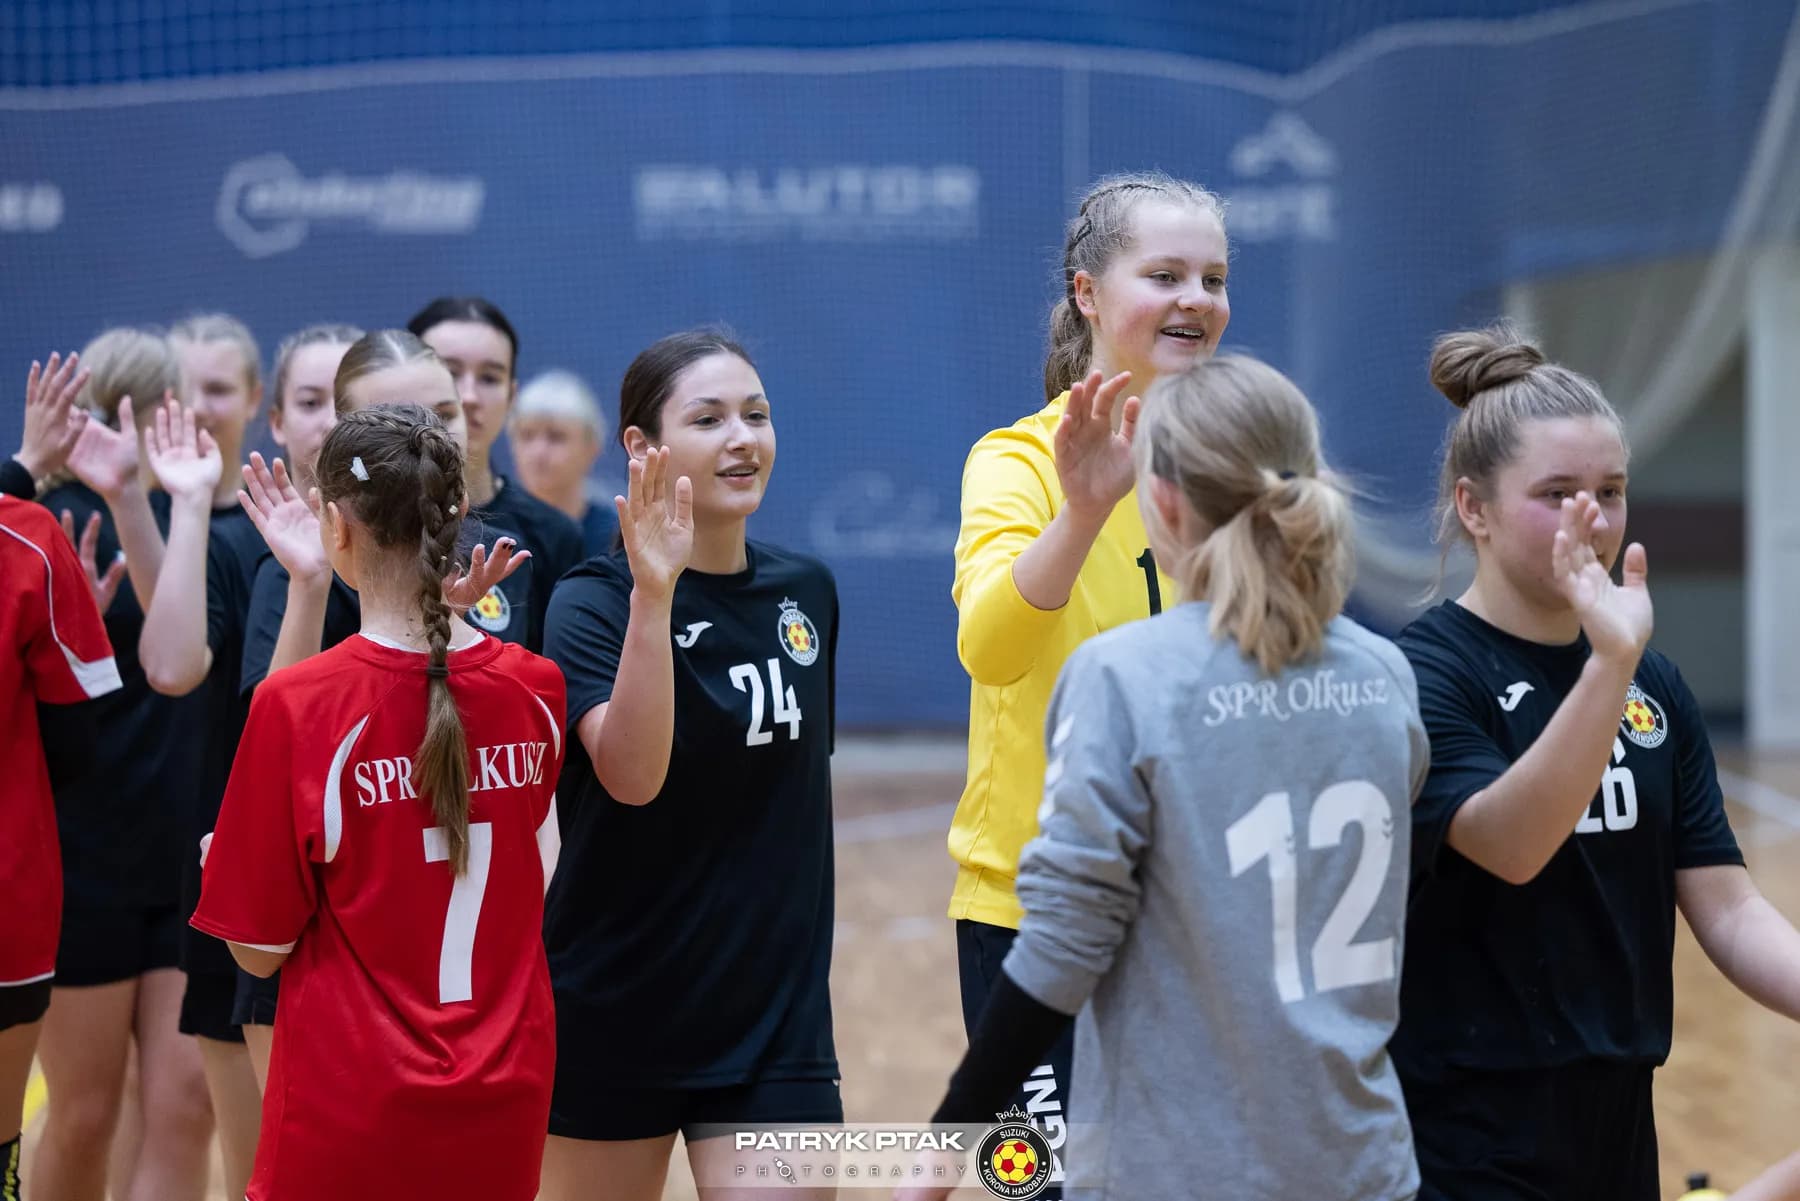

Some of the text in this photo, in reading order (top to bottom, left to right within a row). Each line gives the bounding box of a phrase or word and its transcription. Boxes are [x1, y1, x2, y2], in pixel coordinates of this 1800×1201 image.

[729, 658, 802, 747] 24
[1203, 669, 1388, 728] SPR Olkusz
[354, 742, 548, 807] SPR KUSZ
[422, 822, 492, 1004] 7
[1225, 780, 1395, 1003] 12
